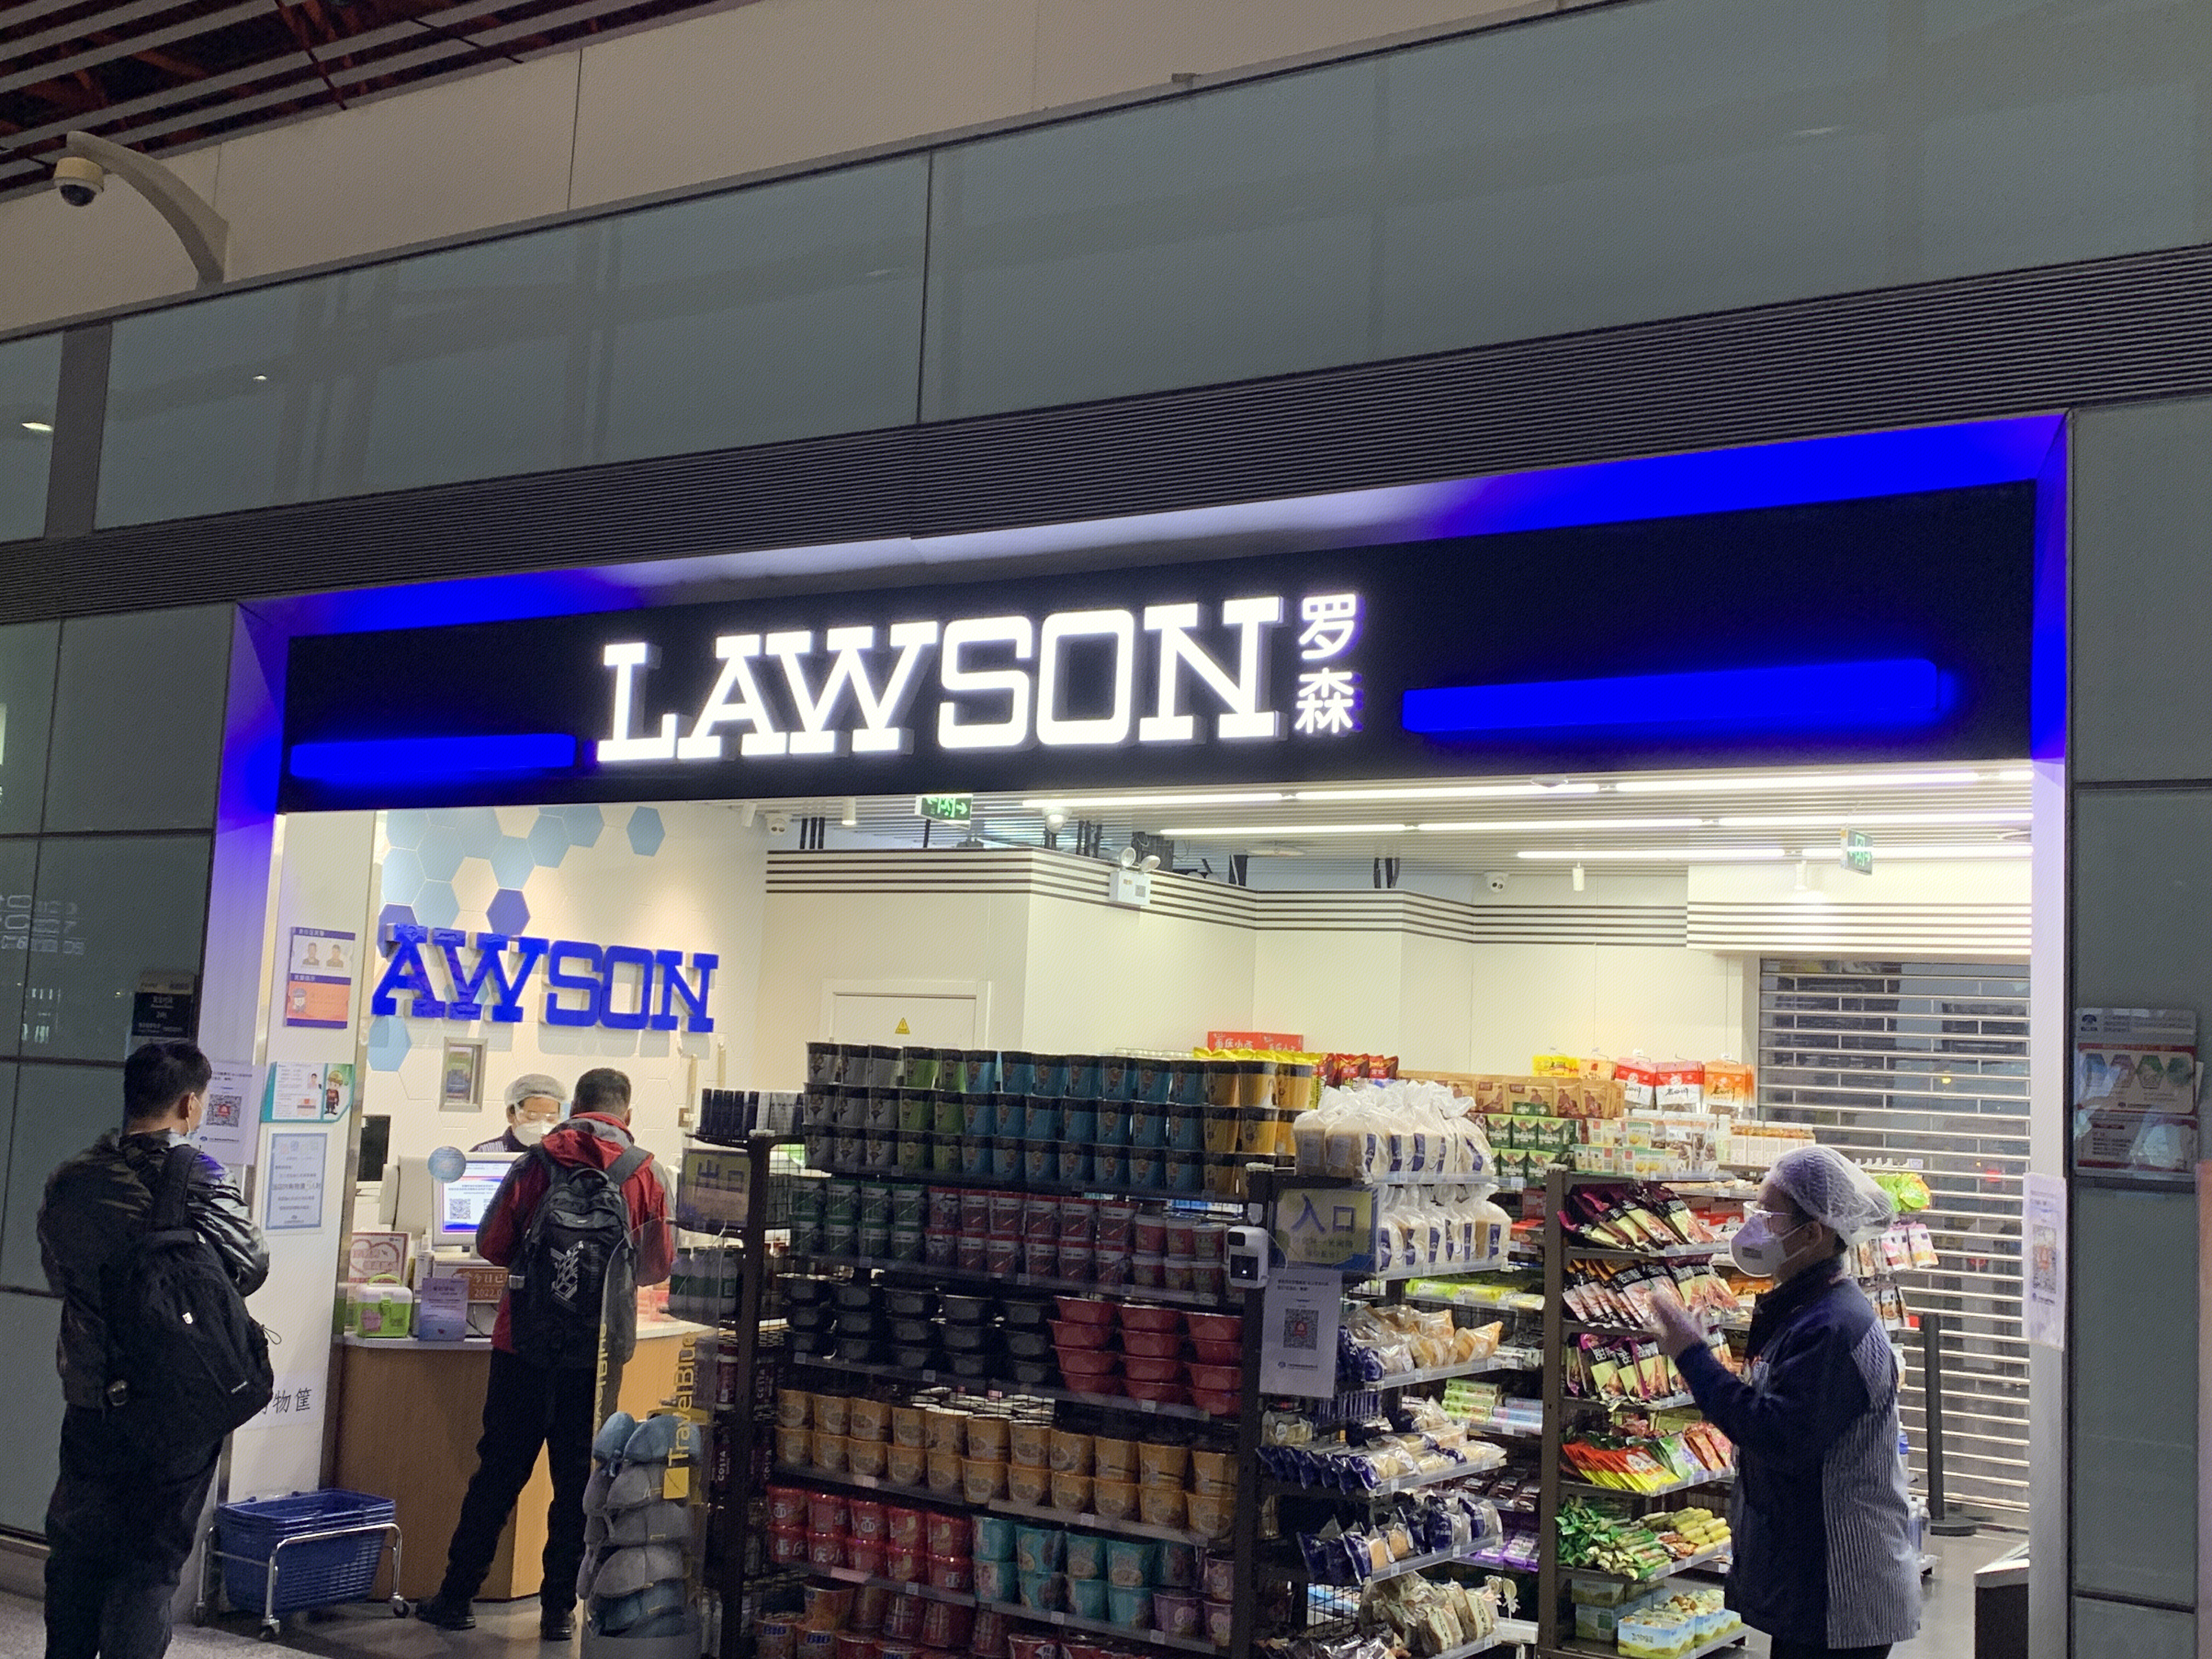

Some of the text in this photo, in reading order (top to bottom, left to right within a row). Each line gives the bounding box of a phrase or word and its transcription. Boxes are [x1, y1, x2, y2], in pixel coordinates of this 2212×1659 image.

[597, 596, 1284, 763] LAWSON
[1297, 592, 1358, 736] 罗森
[371, 923, 719, 1033] AWSON
[696, 1159, 744, 1193] 出口
[1291, 1193, 1356, 1234] 入口
[261, 1387, 312, 1415] 物筐
